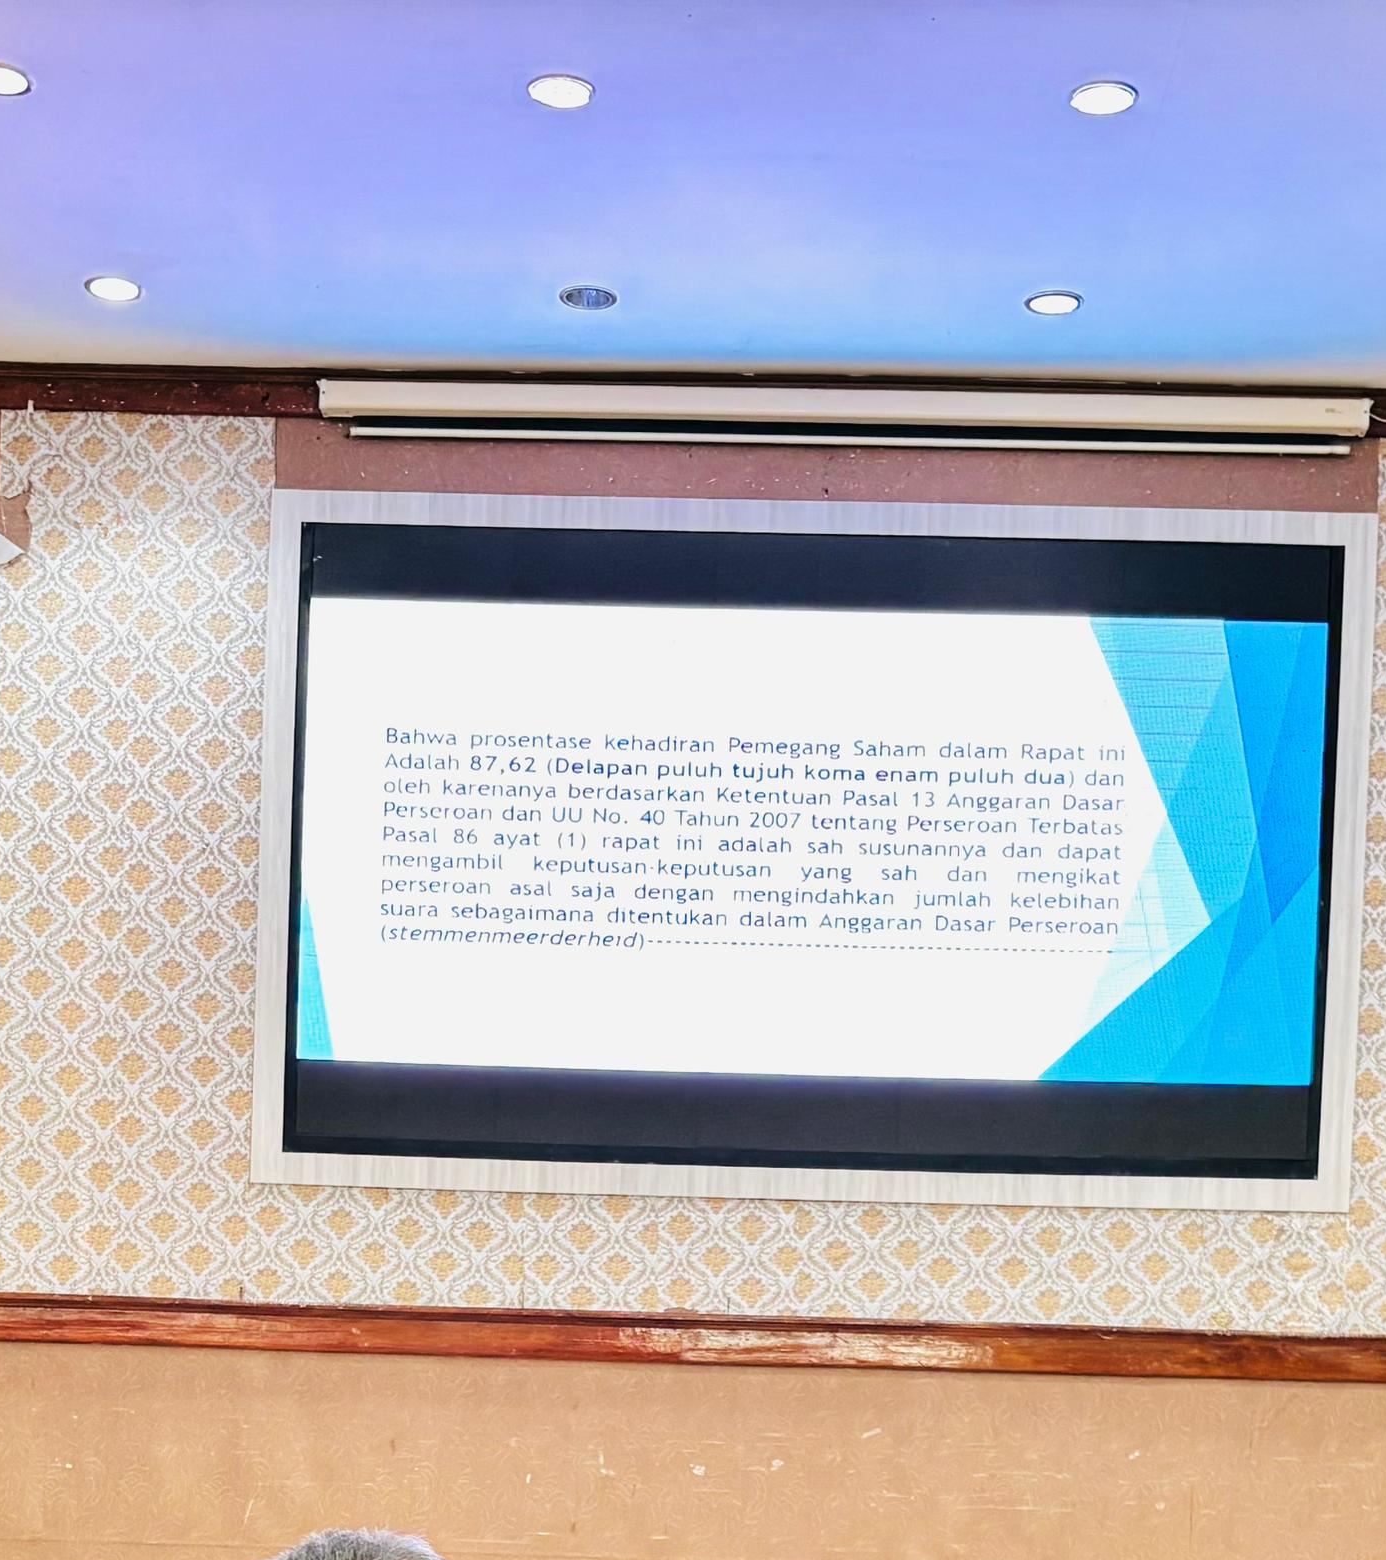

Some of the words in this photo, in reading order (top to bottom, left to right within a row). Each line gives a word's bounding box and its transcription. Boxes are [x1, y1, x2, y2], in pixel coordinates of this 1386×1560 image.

[386, 727, 457, 746] Bahwa
[470, 733, 592, 750] prosentase
[604, 733, 715, 753] kehadiran
[728, 736, 841, 761] Pemegang
[853, 739, 926, 758] Saham
[938, 740, 1008, 760] dalam
[1020, 743, 1085, 765] Rapat
[1098, 745, 1126, 762] ini
[384, 752, 460, 771] Adalah
[469, 754, 537, 776] 87,62
[546, 756, 648, 780] (Delapan
[657, 761, 723, 781] puluh
[732, 762, 794, 784] tujuh
[804, 763, 866, 782] koma
[875, 769, 939, 784] enam
[948, 767, 1014, 788] puluh
[1023, 768, 1075, 789] dua)
[1084, 769, 1125, 787] dan
[383, 777, 431, 795] oleh
[442, 778, 557, 802] karenanya
[568, 783, 705, 803] berdasarkan
[716, 786, 831, 806] Ketentuan
[842, 789, 898, 808] Pasal
[912, 791, 935, 808] 13
[946, 792, 1051, 813] Anggaran
[1062, 793, 1125, 811] Dasar
[383, 800, 493, 821] Perseroan
[501, 804, 542, 823] dan
[551, 806, 583, 824] UU
[592, 807, 628, 825] No.
[639, 809, 666, 826] 40
[673, 809, 740, 828] Tahun
[749, 811, 802, 829] 2007
[811, 813, 897, 836] tentang
[907, 814, 1017, 834] Perseroan
[1028, 817, 1124, 836] Terbatas
[382, 825, 437, 844] Pasal
[453, 827, 478, 845] 86
[493, 831, 541, 850] ayat
[557, 832, 587, 851] (1)
[602, 835, 660, 853] rapat
[676, 834, 703, 852] ini
[717, 836, 792, 854] adalah
[807, 838, 844, 855] sah
[858, 842, 987, 862] susunannya
[1001, 841, 1042, 859] dan
[1057, 843, 1122, 864] dapat
[382, 852, 503, 873] mengambil
[533, 855, 772, 880] keputusan-keputusan
[800, 866, 852, 885] yang
[880, 864, 918, 882] sah
[947, 865, 987, 883] dan
[1017, 867, 1121, 889] mengikat
[381, 879, 491, 895] perseroan
[509, 880, 552, 897] asal
[571, 881, 616, 903] saja
[634, 883, 714, 905] dengan
[733, 887, 894, 907] mengindahkan
[913, 889, 991, 910] jumlah
[1010, 892, 1119, 910] kelebihan
[380, 903, 438, 918] suara
[450, 902, 594, 925] sebagaimana
[606, 906, 727, 927] ditentukan
[739, 910, 808, 929] dalam
[818, 913, 922, 934] Anggaran
[935, 914, 997, 933] Dasar
[1008, 916, 1119, 935] Perseroan
